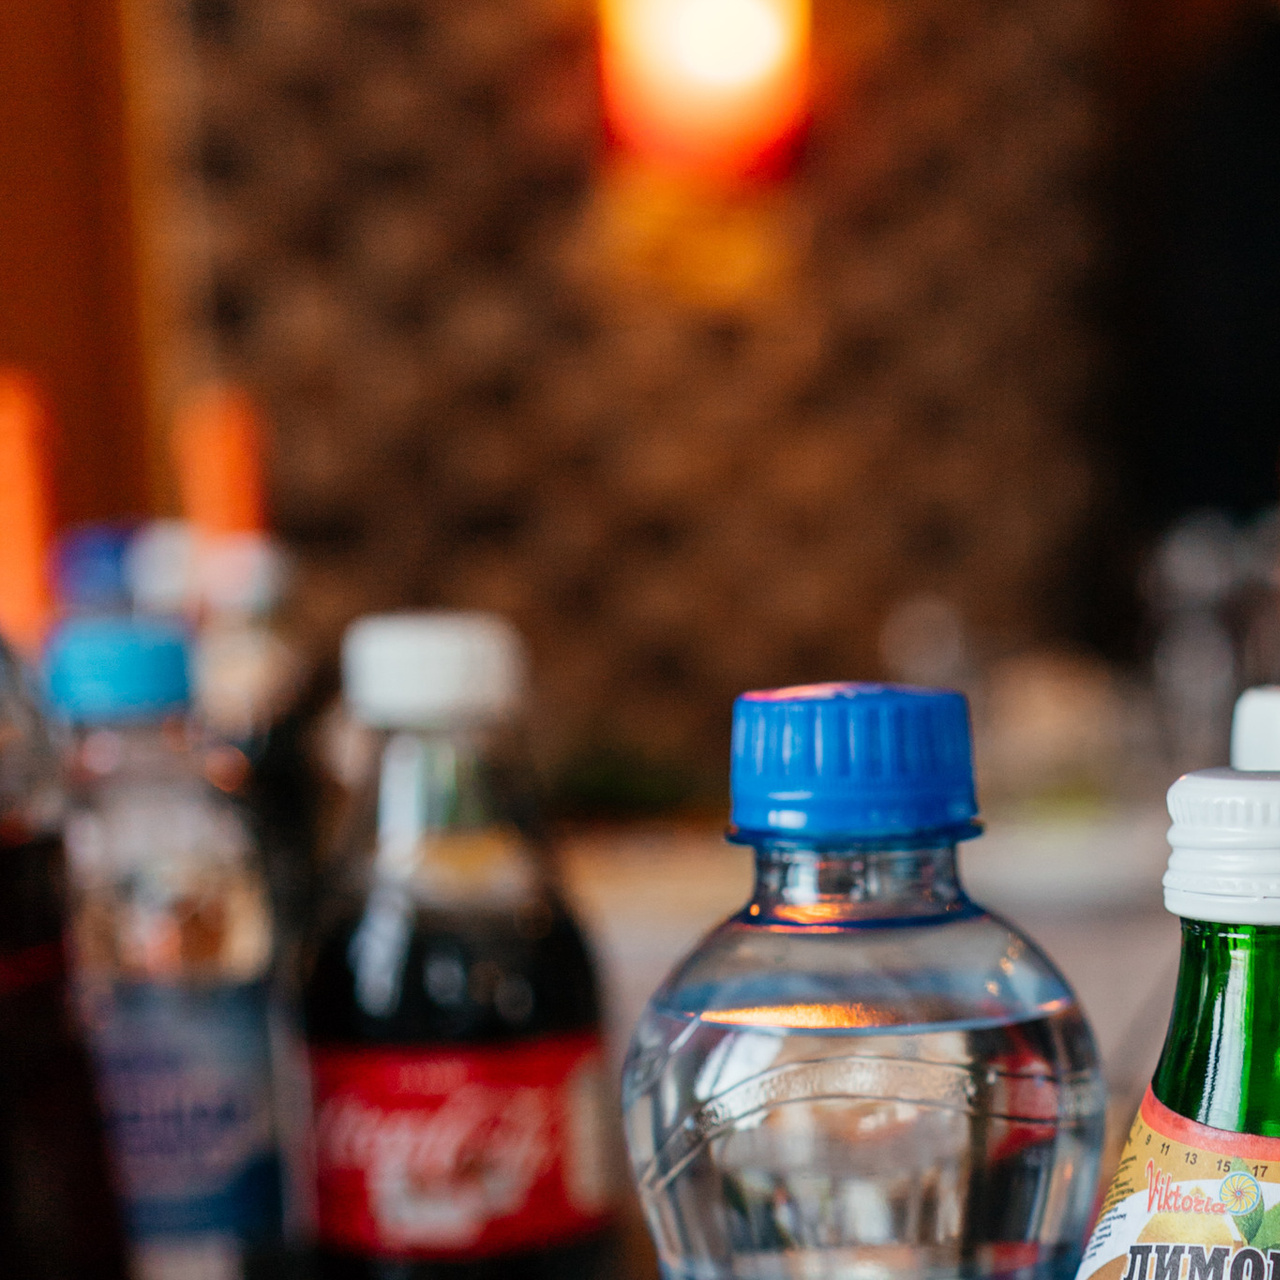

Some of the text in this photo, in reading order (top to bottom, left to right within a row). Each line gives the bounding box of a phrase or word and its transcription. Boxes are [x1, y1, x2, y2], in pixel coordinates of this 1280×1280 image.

[1160, 1142, 1170, 1156] 11
[1184, 1152, 1198, 1165] 13
[1216, 1159, 1232, 1173] 15
[1252, 1165, 1268, 1178] 17
[1146, 1159, 1227, 1213] Viktoria
